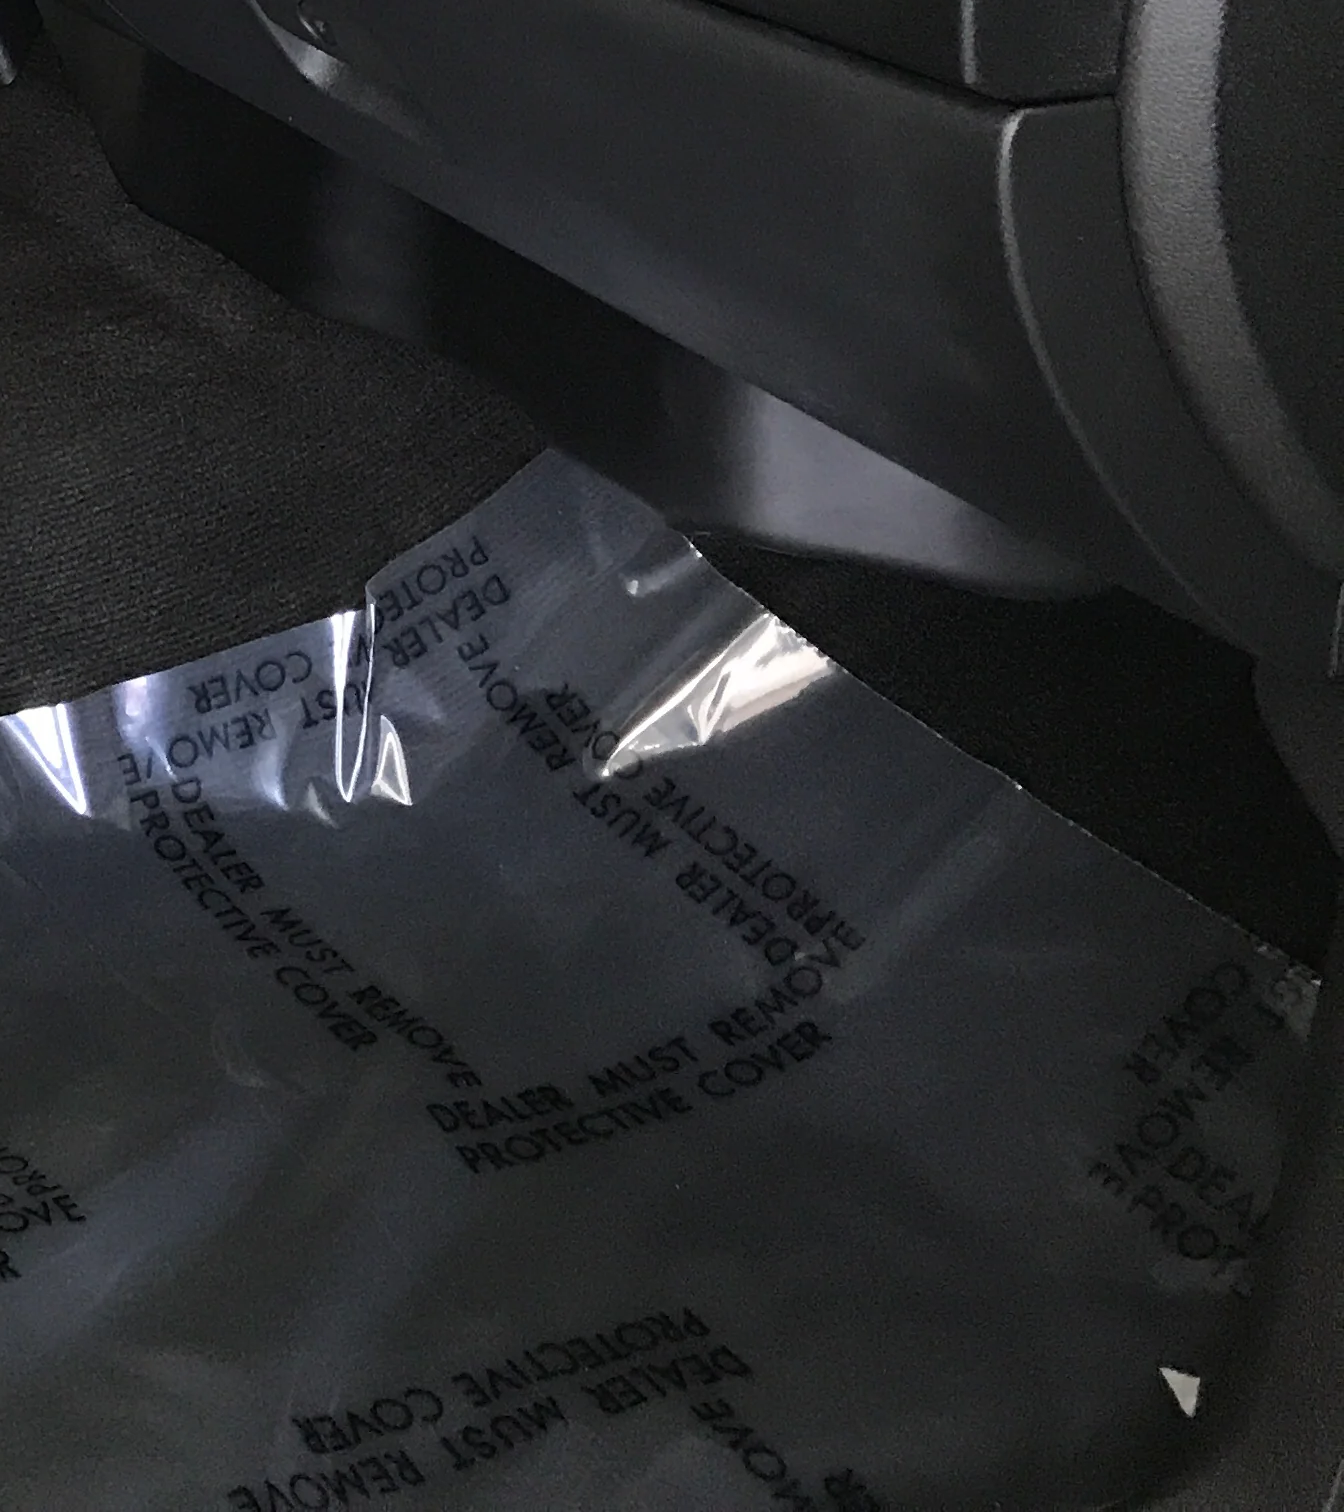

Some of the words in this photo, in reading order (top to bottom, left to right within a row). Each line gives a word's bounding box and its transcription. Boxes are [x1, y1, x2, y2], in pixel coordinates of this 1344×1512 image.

[381, 573, 511, 668] DEALER
[186, 651, 312, 714] COVER
[457, 633, 576, 773] REMOVE
[573, 782, 673, 859] MUST
[643, 776, 837, 934] PROTECTIVE
[130, 789, 282, 960] PROTECTIVE
[275, 966, 378, 1052] COVER
[172, 777, 265, 893] DEALER
[261, 906, 355, 976] MUST
[351, 985, 483, 1089] REMOVE
[675, 860, 799, 968] DEALER
[425, 1081, 574, 1133] DEALER
[587, 1037, 699, 1097] MUST
[707, 919, 865, 1046] REMOVE
[455, 1087, 693, 1174] PROTECTIVE
[697, 1021, 833, 1097] COVER
[451, 1307, 712, 1407] PROTECTIVE
[581, 1344, 753, 1415] DEALER
[292, 1388, 444, 1454] COVER
[441, 1395, 565, 1470] MUST
[689, 1398, 815, 1512] MOVE
[226, 1448, 426, 1512] REMOVE
